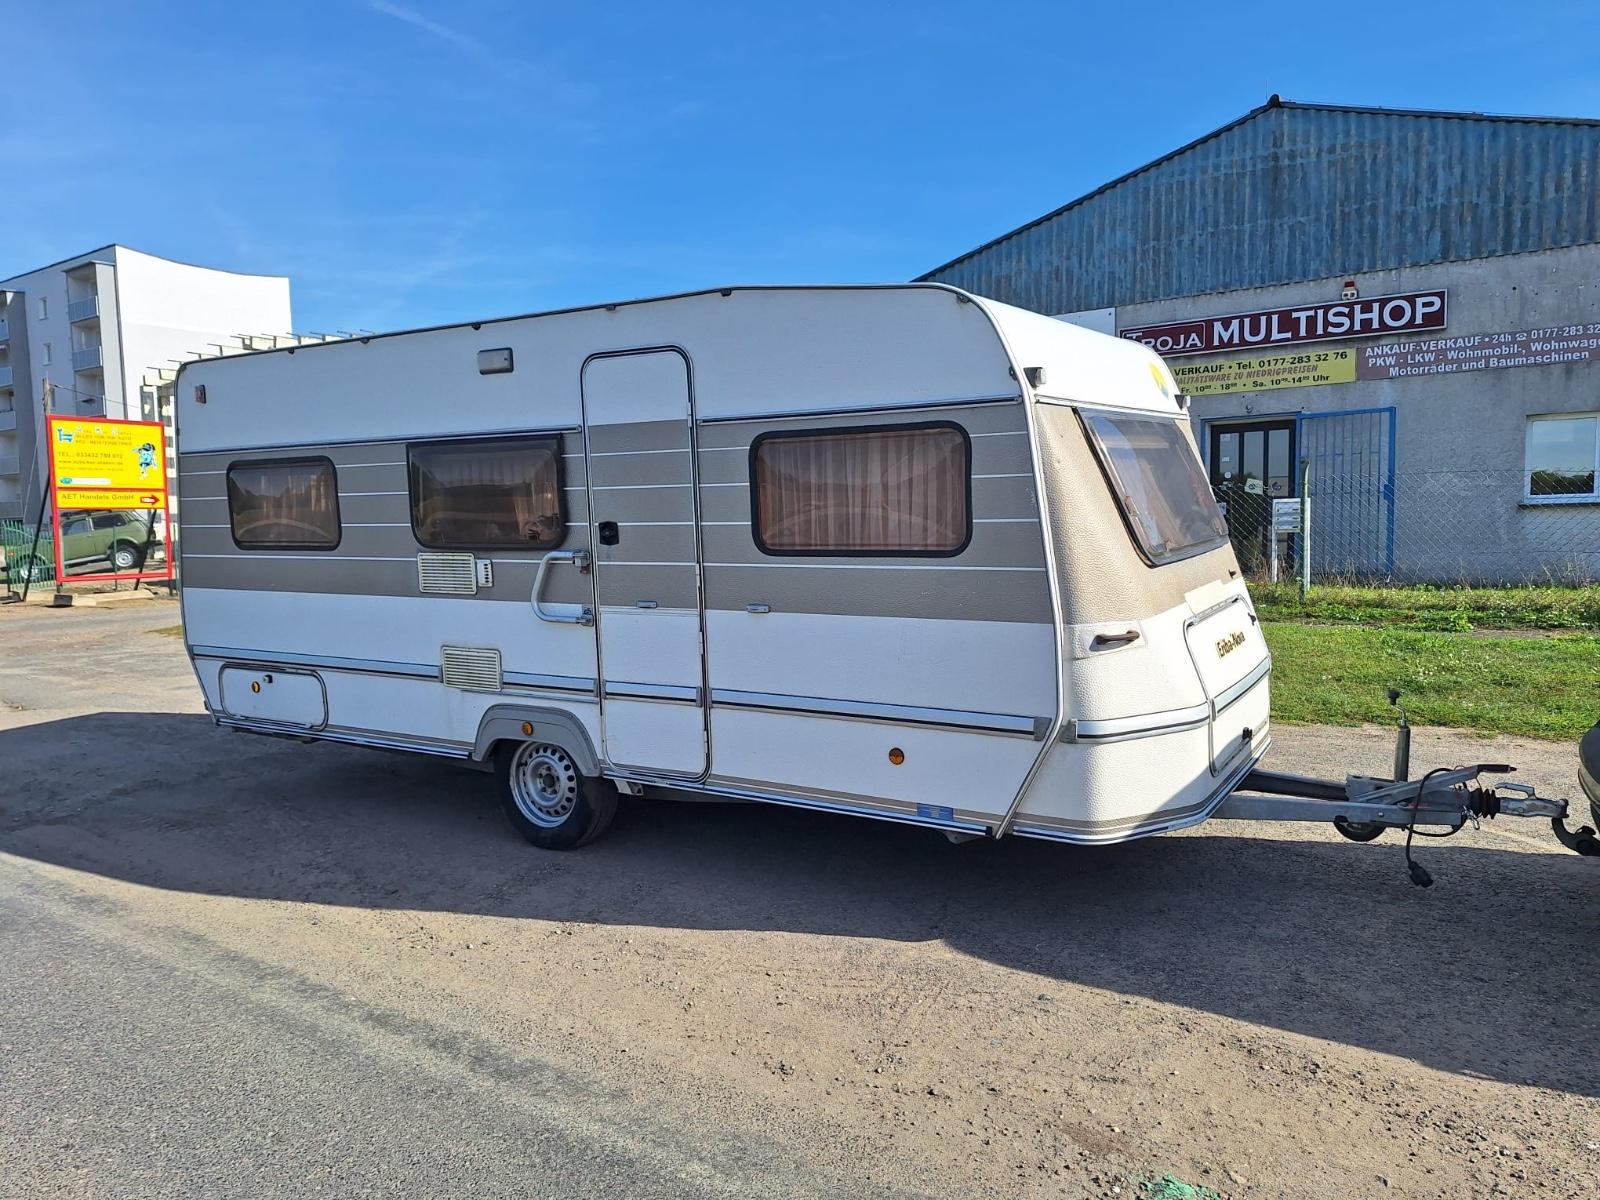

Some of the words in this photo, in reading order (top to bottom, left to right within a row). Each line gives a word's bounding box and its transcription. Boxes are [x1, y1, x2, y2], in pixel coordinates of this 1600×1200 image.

[1126, 332, 1202, 351] TROJA
[1213, 296, 1441, 346] MULTISHOP
[1365, 336, 1481, 356] ANKAUF-VERKAUF
[1492, 334, 1511, 344] 24h
[1531, 326, 1583, 339] 0177-283
[1235, 361, 1254, 370] Tel.
[1258, 353, 1311, 368] 0177-283
[1315, 353, 1329, 362] 32
[1333, 351, 1347, 360] 76
[1368, 355, 1396, 367] PKW
[1407, 352, 1435, 364] LKW
[1389, 362, 1458, 377] Motorräder
[1461, 358, 1485, 370] und
[1489, 351, 1589, 367] Baumaschinen
[1234, 371, 1246, 379] ZU
[1247, 364, 1318, 378] NIEDRIGPREISEN
[1252, 380, 1266, 388] Sa.
[1312, 374, 1330, 382] Uhr
